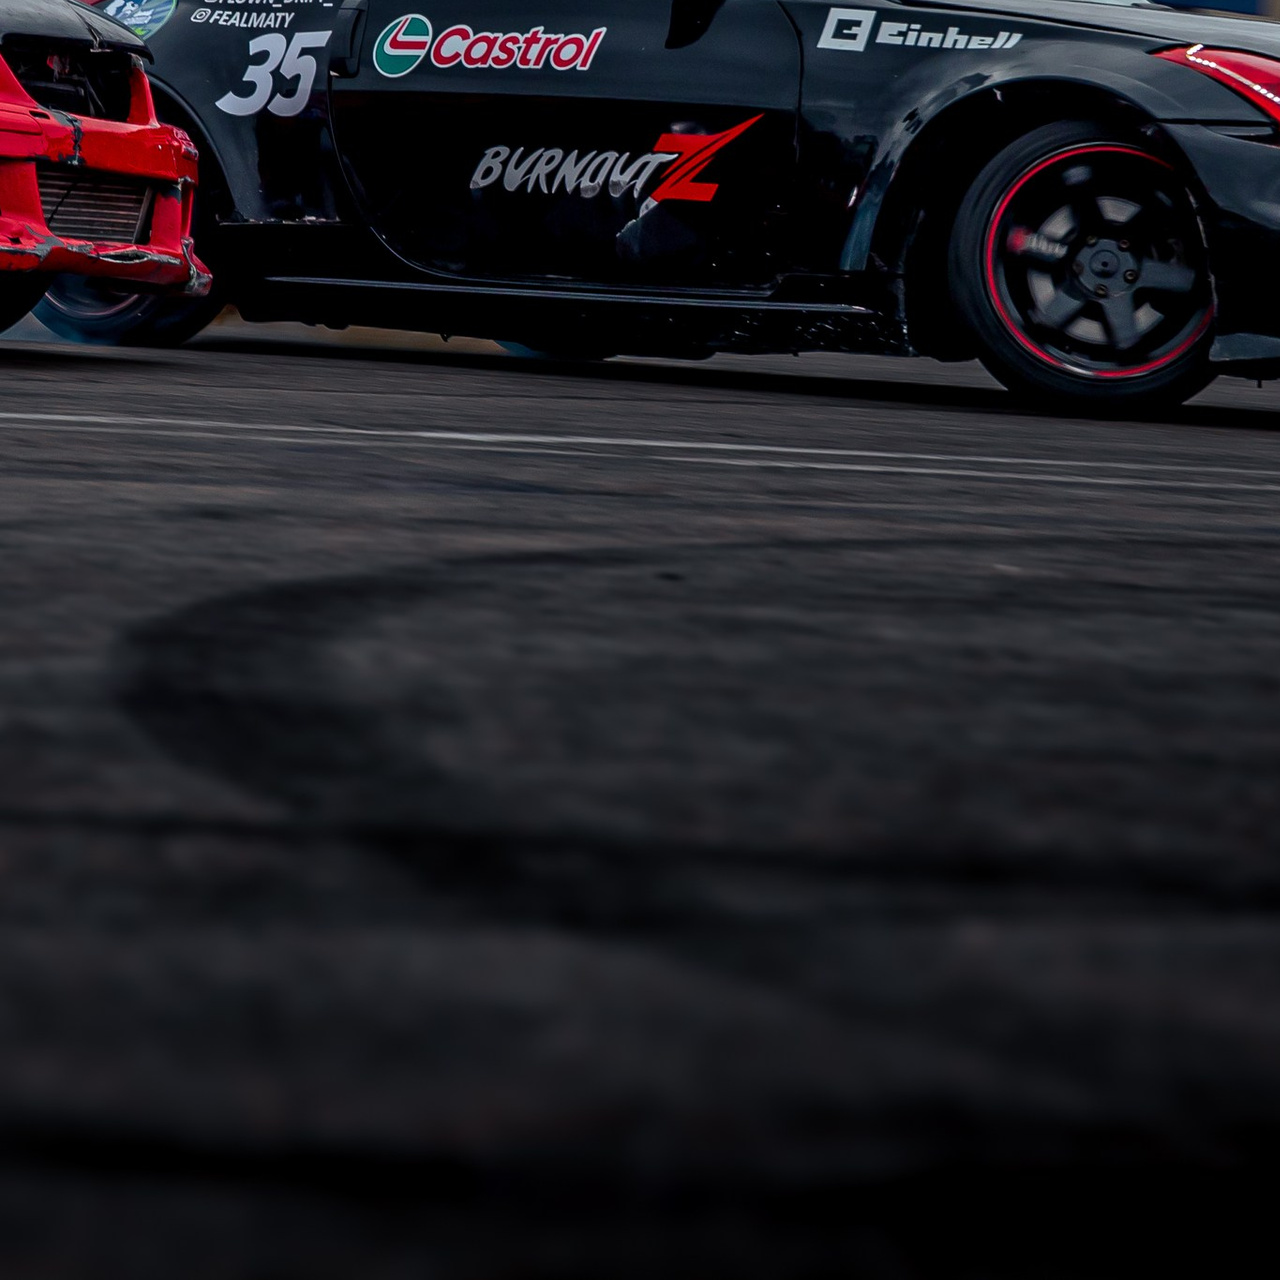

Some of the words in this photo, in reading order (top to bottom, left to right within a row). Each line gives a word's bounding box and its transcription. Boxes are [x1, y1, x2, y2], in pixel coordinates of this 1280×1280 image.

[209, 10, 295, 28] FEALMATY
[875, 21, 1023, 49] Einhell
[431, 25, 607, 70] Castrol
[215, 30, 332, 117] 35
